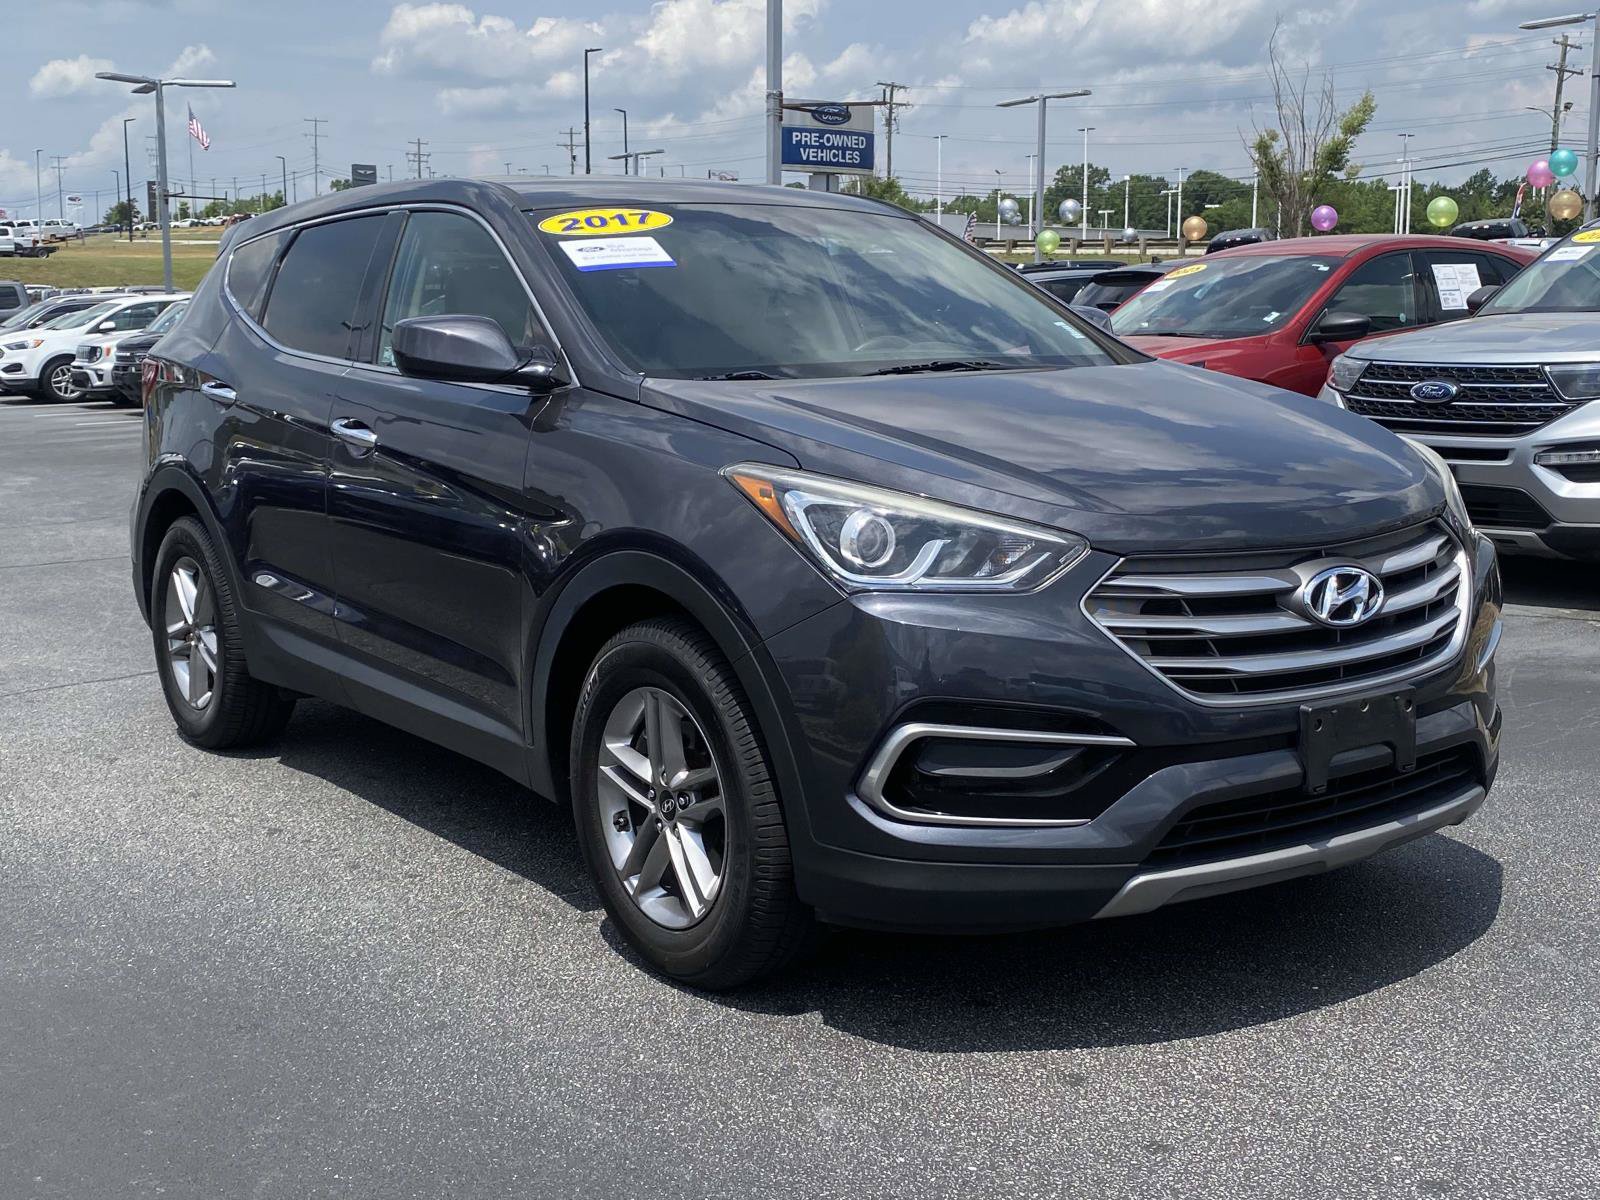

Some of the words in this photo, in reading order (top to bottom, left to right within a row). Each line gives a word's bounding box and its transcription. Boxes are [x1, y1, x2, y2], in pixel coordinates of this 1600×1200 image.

[792, 132, 866, 148] PRE-OWNED
[800, 148, 860, 163] VEHICLES
[558, 212, 652, 232] 2017
[1420, 385, 1445, 398] Ford
